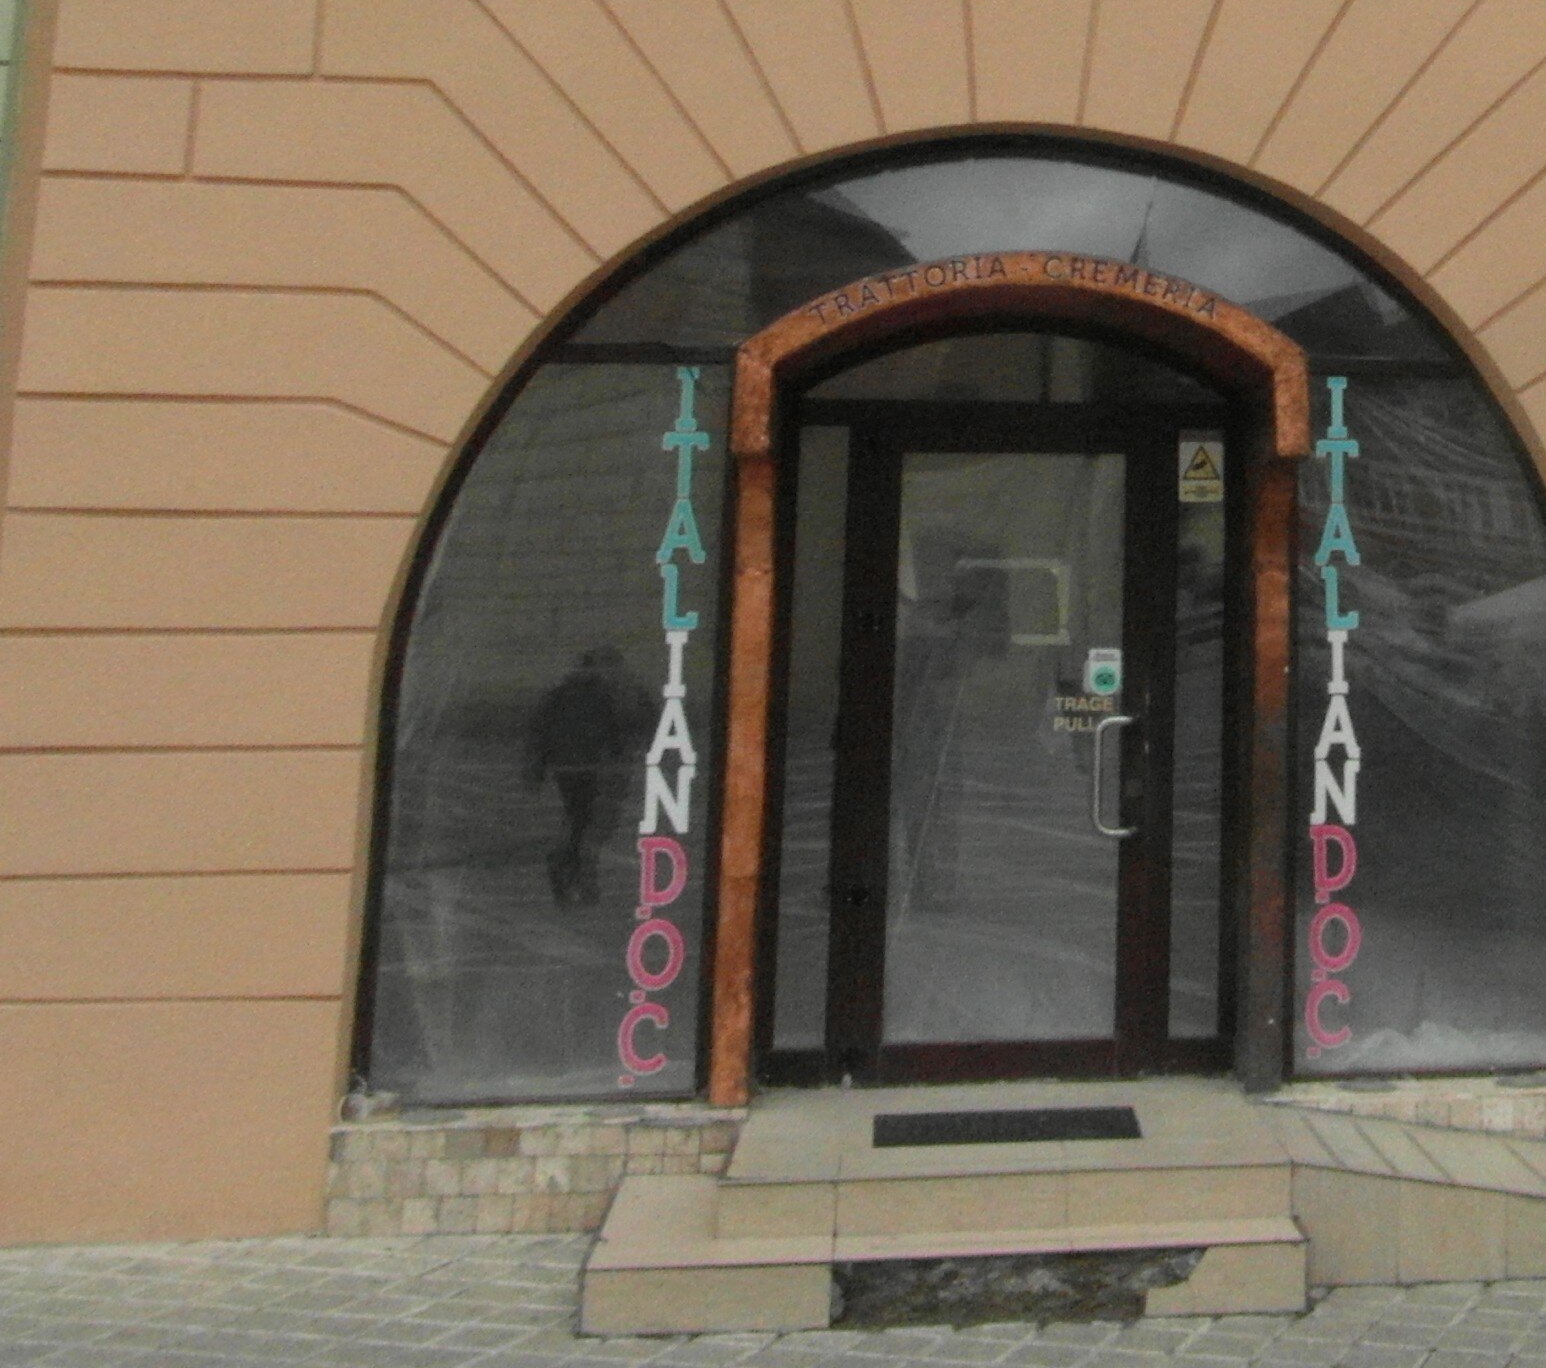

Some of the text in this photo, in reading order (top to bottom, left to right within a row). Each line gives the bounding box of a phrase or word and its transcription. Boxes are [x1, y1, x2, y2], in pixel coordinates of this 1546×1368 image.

[809, 256, 1008, 324] TRATTORIA
[1044, 255, 1216, 320] CREMERIA
[639, 367, 710, 834] ITALIAN
[1309, 376, 1361, 825] ITALIAN
[1053, 716, 1096, 732] PULL
[1055, 696, 1115, 712] TRAGE
